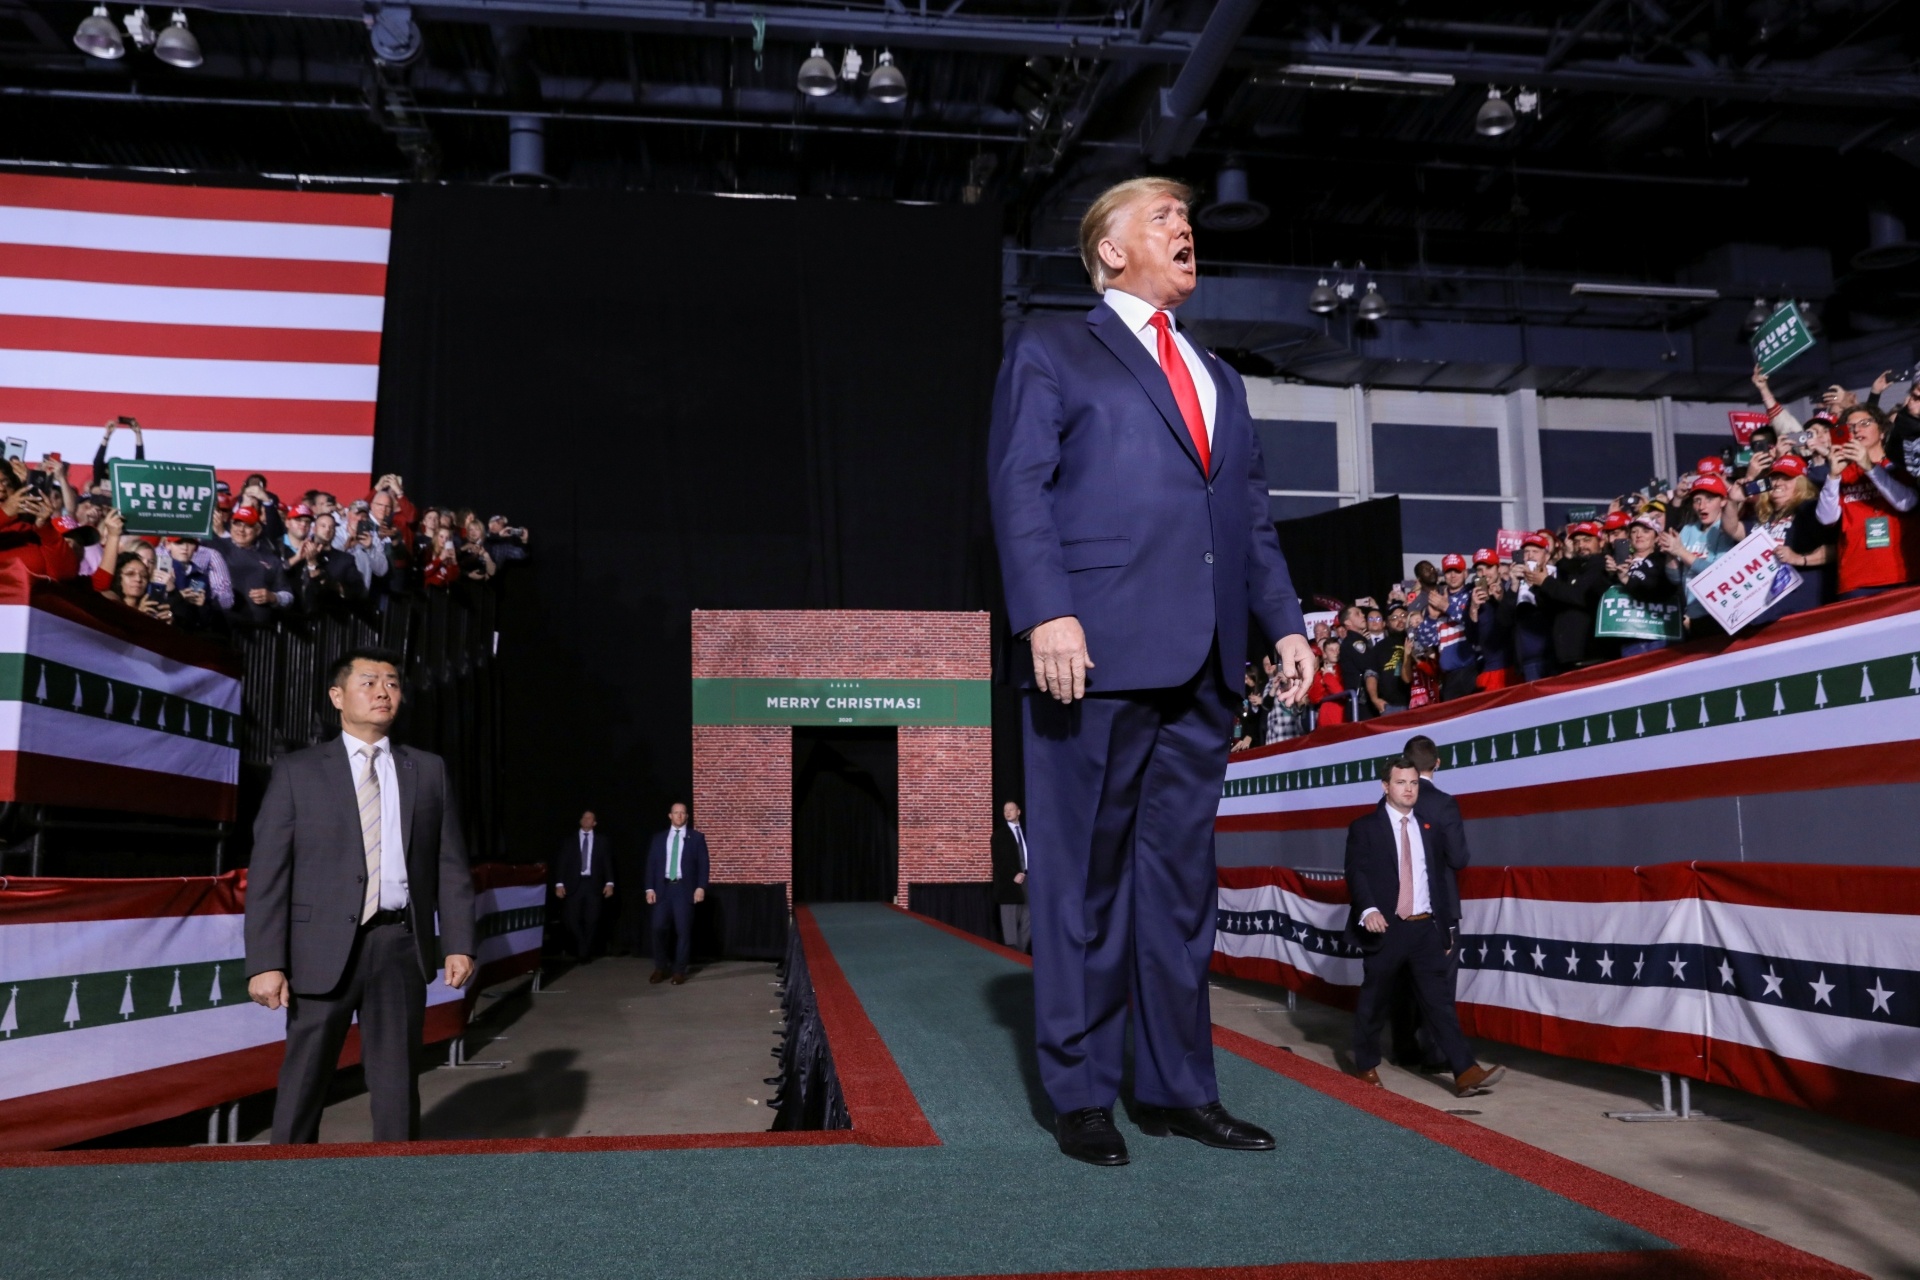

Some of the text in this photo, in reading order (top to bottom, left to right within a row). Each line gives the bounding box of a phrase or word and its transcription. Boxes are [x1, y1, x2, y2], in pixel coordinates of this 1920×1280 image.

[120, 482, 212, 500] TRUMP
[130, 498, 203, 511] PENCE
[1705, 549, 1774, 603] TRUMP
[1720, 563, 1778, 608] PENCE
[1604, 598, 1678, 614] TRUMP
[1608, 609, 1672, 620] PENCE
[767, 697, 921, 709] MERRY CHRISTMAS!
